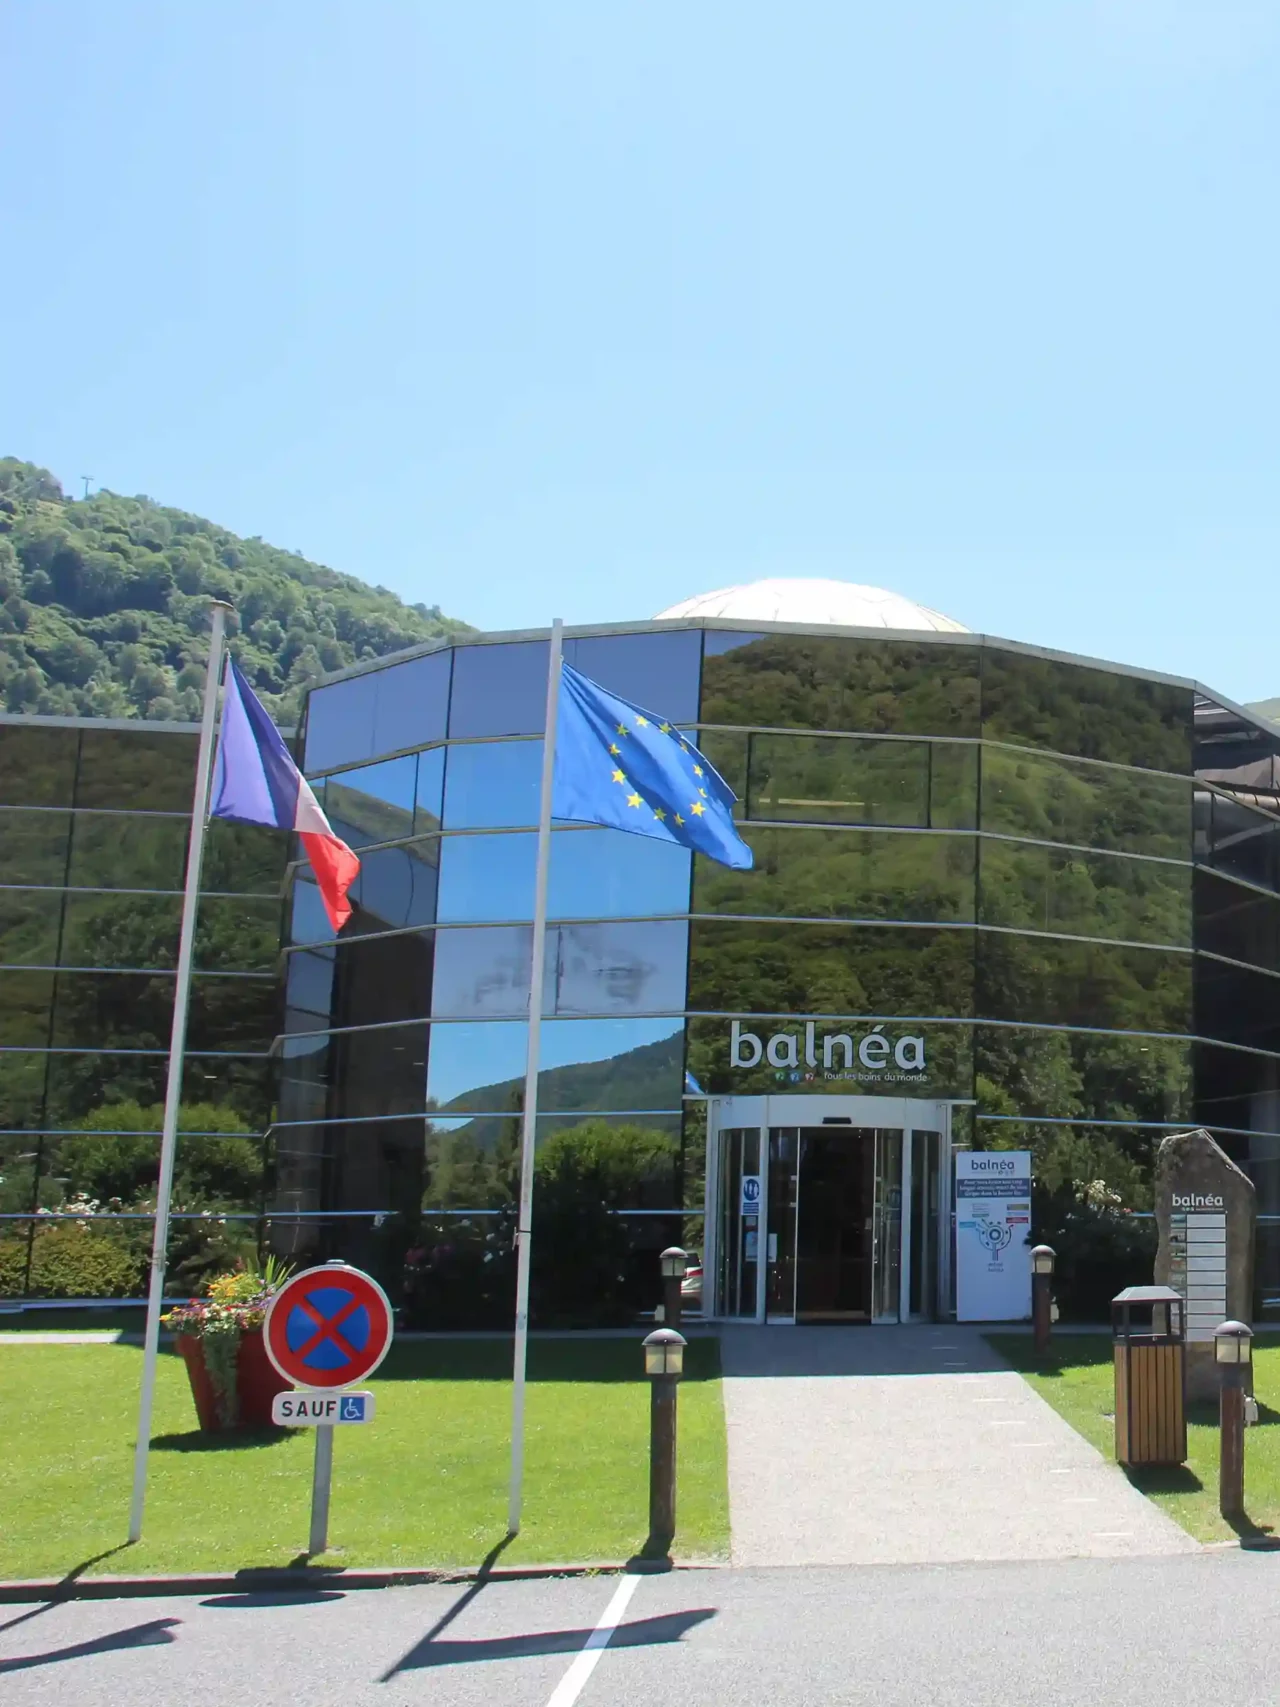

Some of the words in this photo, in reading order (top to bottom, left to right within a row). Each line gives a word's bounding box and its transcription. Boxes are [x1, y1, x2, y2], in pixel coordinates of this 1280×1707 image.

[730, 1020, 926, 1070] balnéa
[858, 1072, 881, 1081] bains
[884, 1073, 896, 1081] du
[897, 1073, 927, 1082] monde
[971, 1159, 1015, 1170] balnéa
[1172, 1193, 1224, 1206] balnéa
[282, 1400, 336, 1417] SAUF
